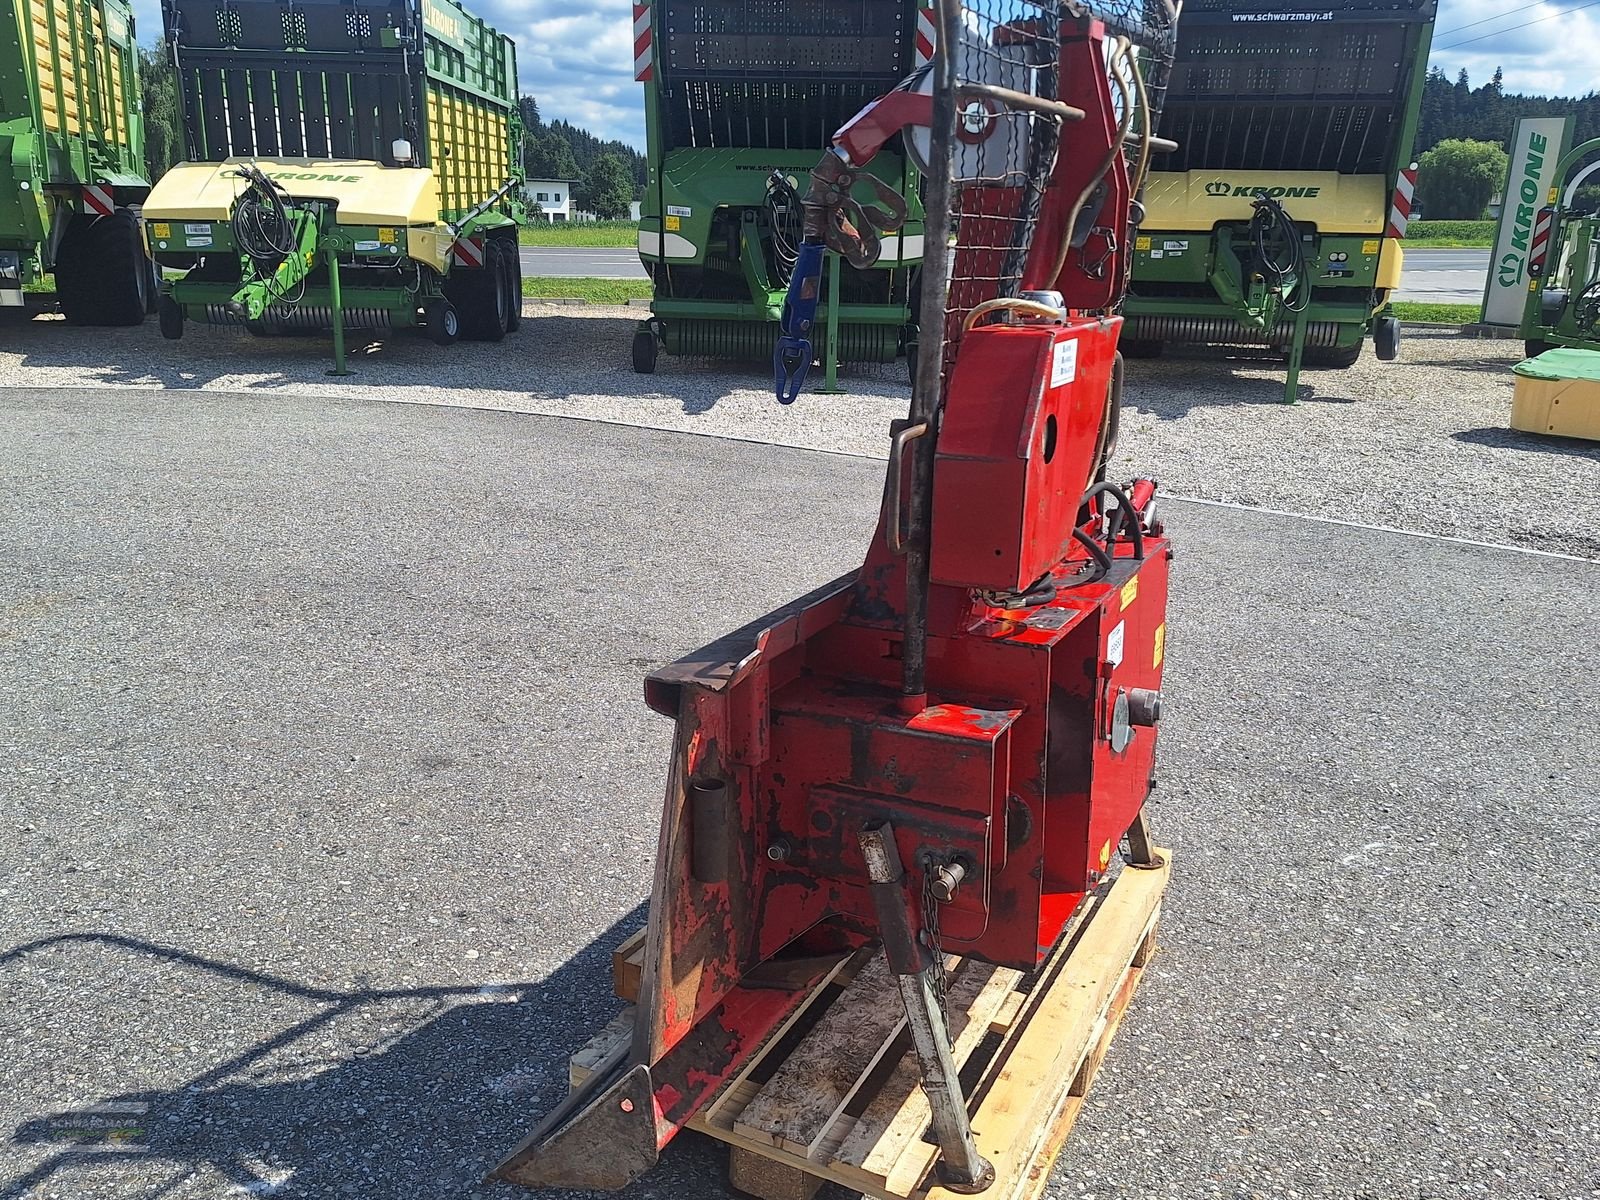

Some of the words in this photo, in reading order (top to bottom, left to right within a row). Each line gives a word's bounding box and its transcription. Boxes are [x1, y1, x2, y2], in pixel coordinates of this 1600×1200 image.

[430, 5, 455, 40] KRONE
[1232, 11, 1334, 22] www.schwarzmayr.at
[1232, 186, 1321, 198] KRONE
[1510, 131, 1548, 252] KRONE
